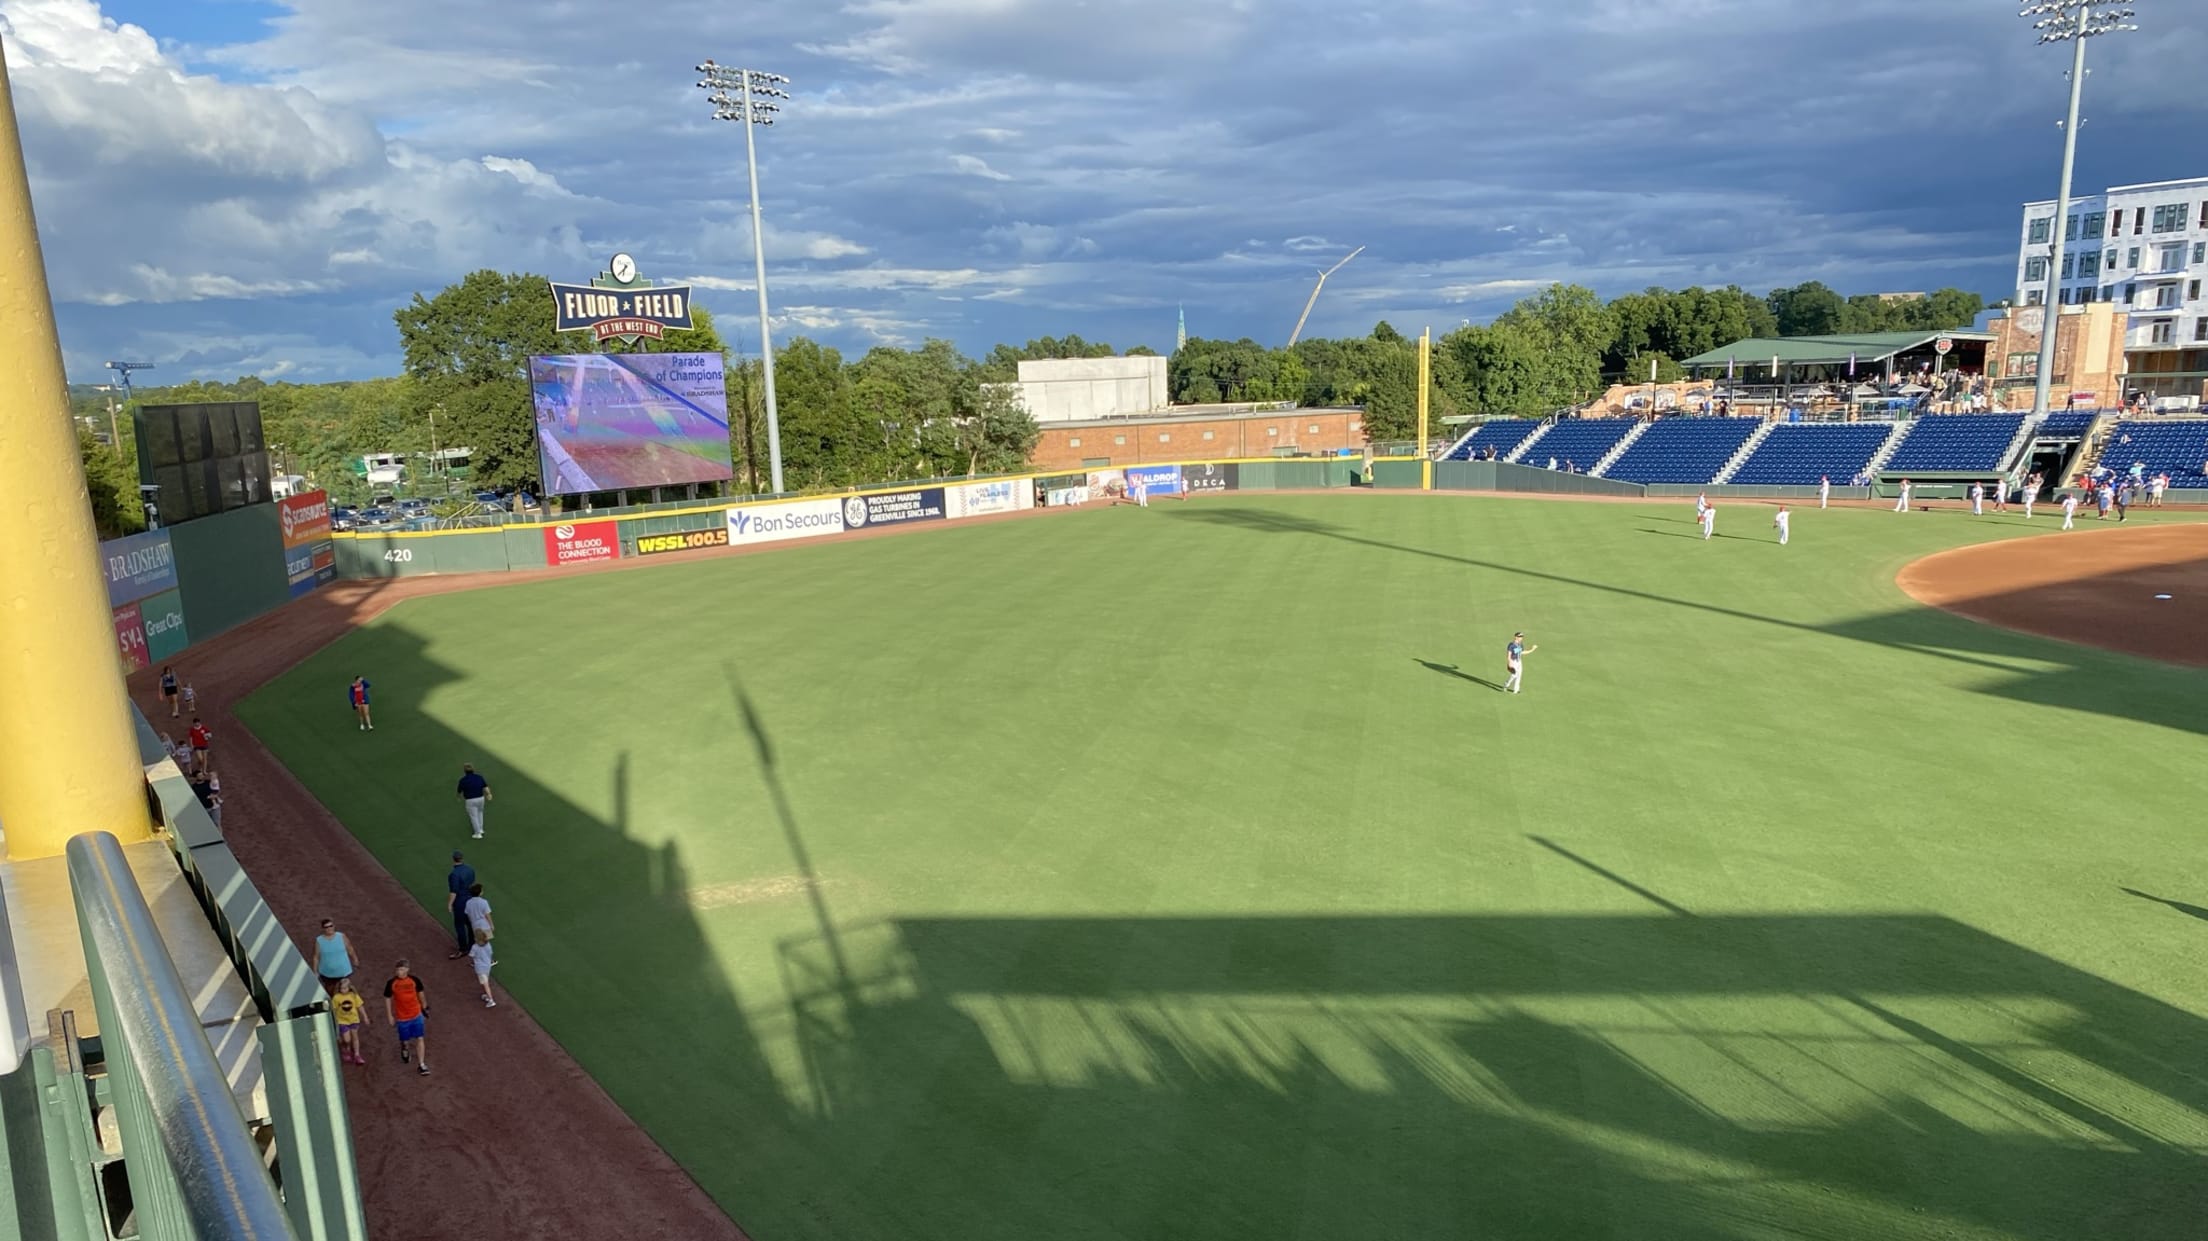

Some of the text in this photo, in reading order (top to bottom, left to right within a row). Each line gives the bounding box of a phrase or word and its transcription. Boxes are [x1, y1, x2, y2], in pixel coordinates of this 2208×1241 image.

[564, 293, 684, 319] FLUOR FIELD
[600, 321, 659, 335] AT THE WEST END
[672, 355, 705, 367] Parade
[656, 369, 723, 384] of Champions
[1194, 479, 1226, 487] DECA
[897, 492, 922, 502] MAKING
[869, 504, 883, 514] GAS
[883, 501, 913, 512] TURBINES
[870, 510, 906, 523] GREENVILLE
[907, 508, 924, 518] SINCE
[753, 512, 841, 533] Bon Secours
[557, 539, 603, 550] THE BLOOD
[384, 549, 413, 562] 420
[558, 547, 611, 560] CONNECTION
[109, 542, 170, 582] BRADSHAW
[146, 612, 183, 637] Great Clips
